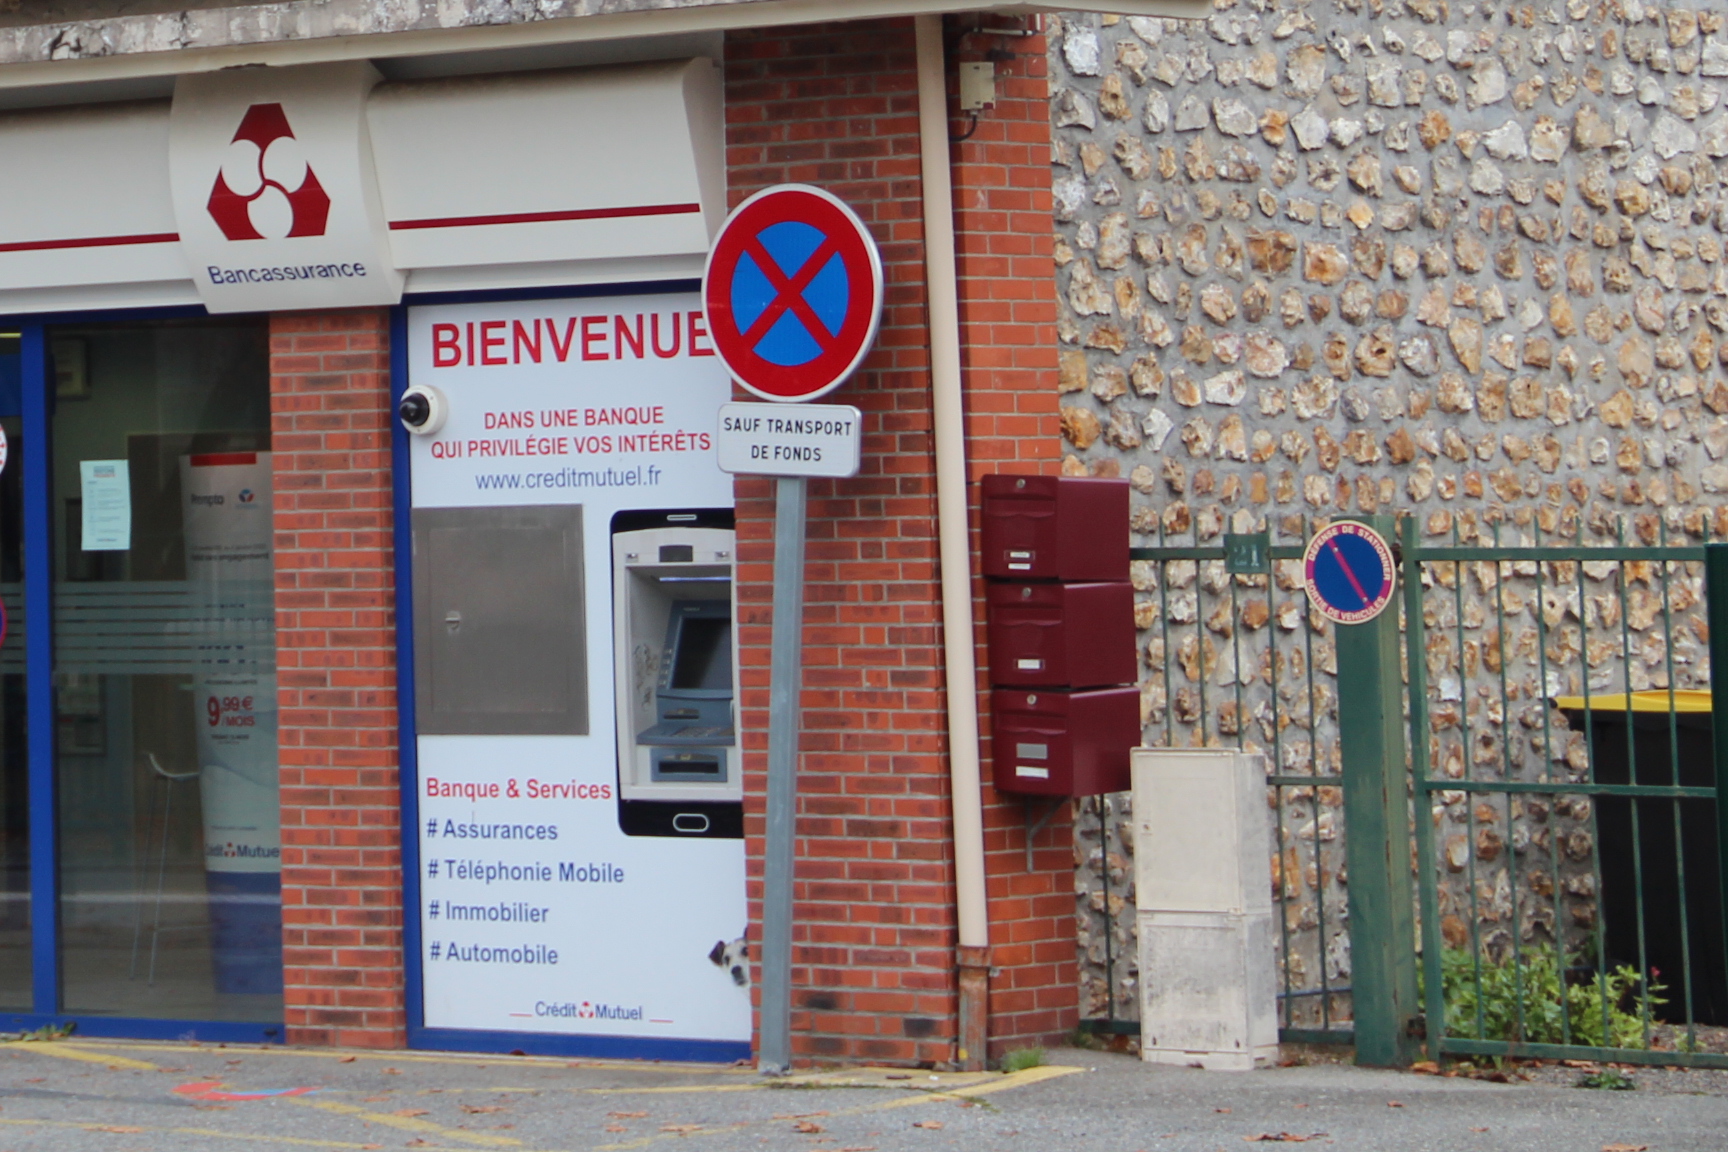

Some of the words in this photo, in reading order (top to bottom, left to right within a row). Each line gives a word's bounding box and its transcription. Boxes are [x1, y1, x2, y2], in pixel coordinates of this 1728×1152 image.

[207, 262, 366, 284] Bancassurance
[432, 310, 715, 368] BIENVENUE
[484, 411, 534, 429] DANS
[541, 409, 578, 428] UNE
[584, 406, 664, 426] BANQUE
[724, 417, 761, 432] SAUF
[767, 419, 852, 436] TRANSPORT
[431, 441, 462, 459] QUI
[468, 434, 568, 457] PRIVILÉGIE
[574, 436, 612, 454] VOS
[619, 429, 711, 453] INTÉRÊTS
[751, 445, 769, 459] DE
[774, 446, 822, 461] FONDS
[475, 465, 662, 489] www.creditmutuel.fr
[1341, 525, 1355, 534] DE
[1357, 529, 1391, 581] STATIONNER
[1306, 578, 1328, 610] SORTIE
[1327, 606, 1340, 619] DE
[426, 777, 500, 803] Banque
[506, 778, 520, 798] &
[527, 778, 612, 799] Services
[427, 818, 438, 838] #
[443, 819, 558, 840] Assurances
[237, 844, 280, 858] Mutue
[428, 859, 439, 878] #
[444, 859, 552, 885] Téléphonie
[559, 861, 624, 883] Mobile
[429, 900, 440, 919] #
[446, 901, 549, 922] Immobilier
[430, 941, 441, 961] #
[446, 941, 558, 964] Automobile
[535, 1001, 577, 1018] Crédit
[595, 1004, 642, 1020] Mutuel
